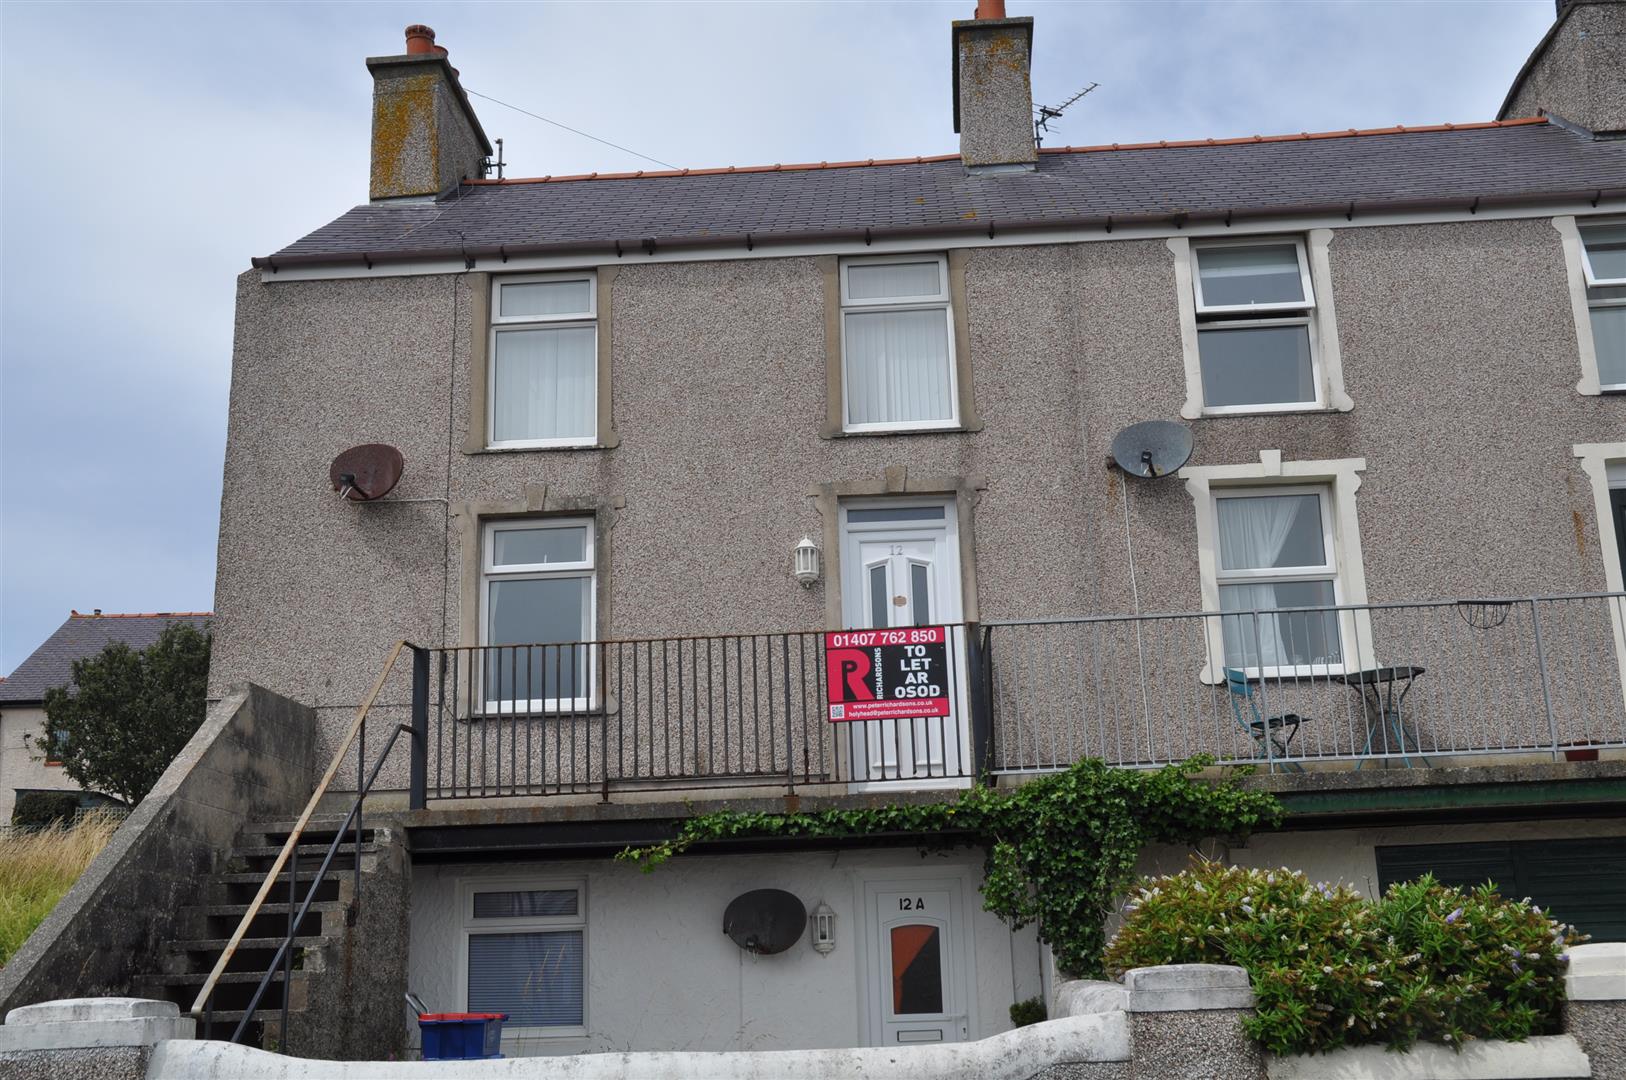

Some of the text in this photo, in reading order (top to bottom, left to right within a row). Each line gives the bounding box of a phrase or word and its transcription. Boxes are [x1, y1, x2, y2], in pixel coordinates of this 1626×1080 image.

[889, 545, 903, 556] 12
[833, 630, 937, 647] 01407 762 850
[904, 645, 926, 657] TO
[900, 658, 932, 671] LET
[875, 647, 884, 700] RICHARDSONS
[905, 672, 929, 684] AR
[895, 685, 941, 698] OSOD
[899, 897, 924, 910] 12 A
